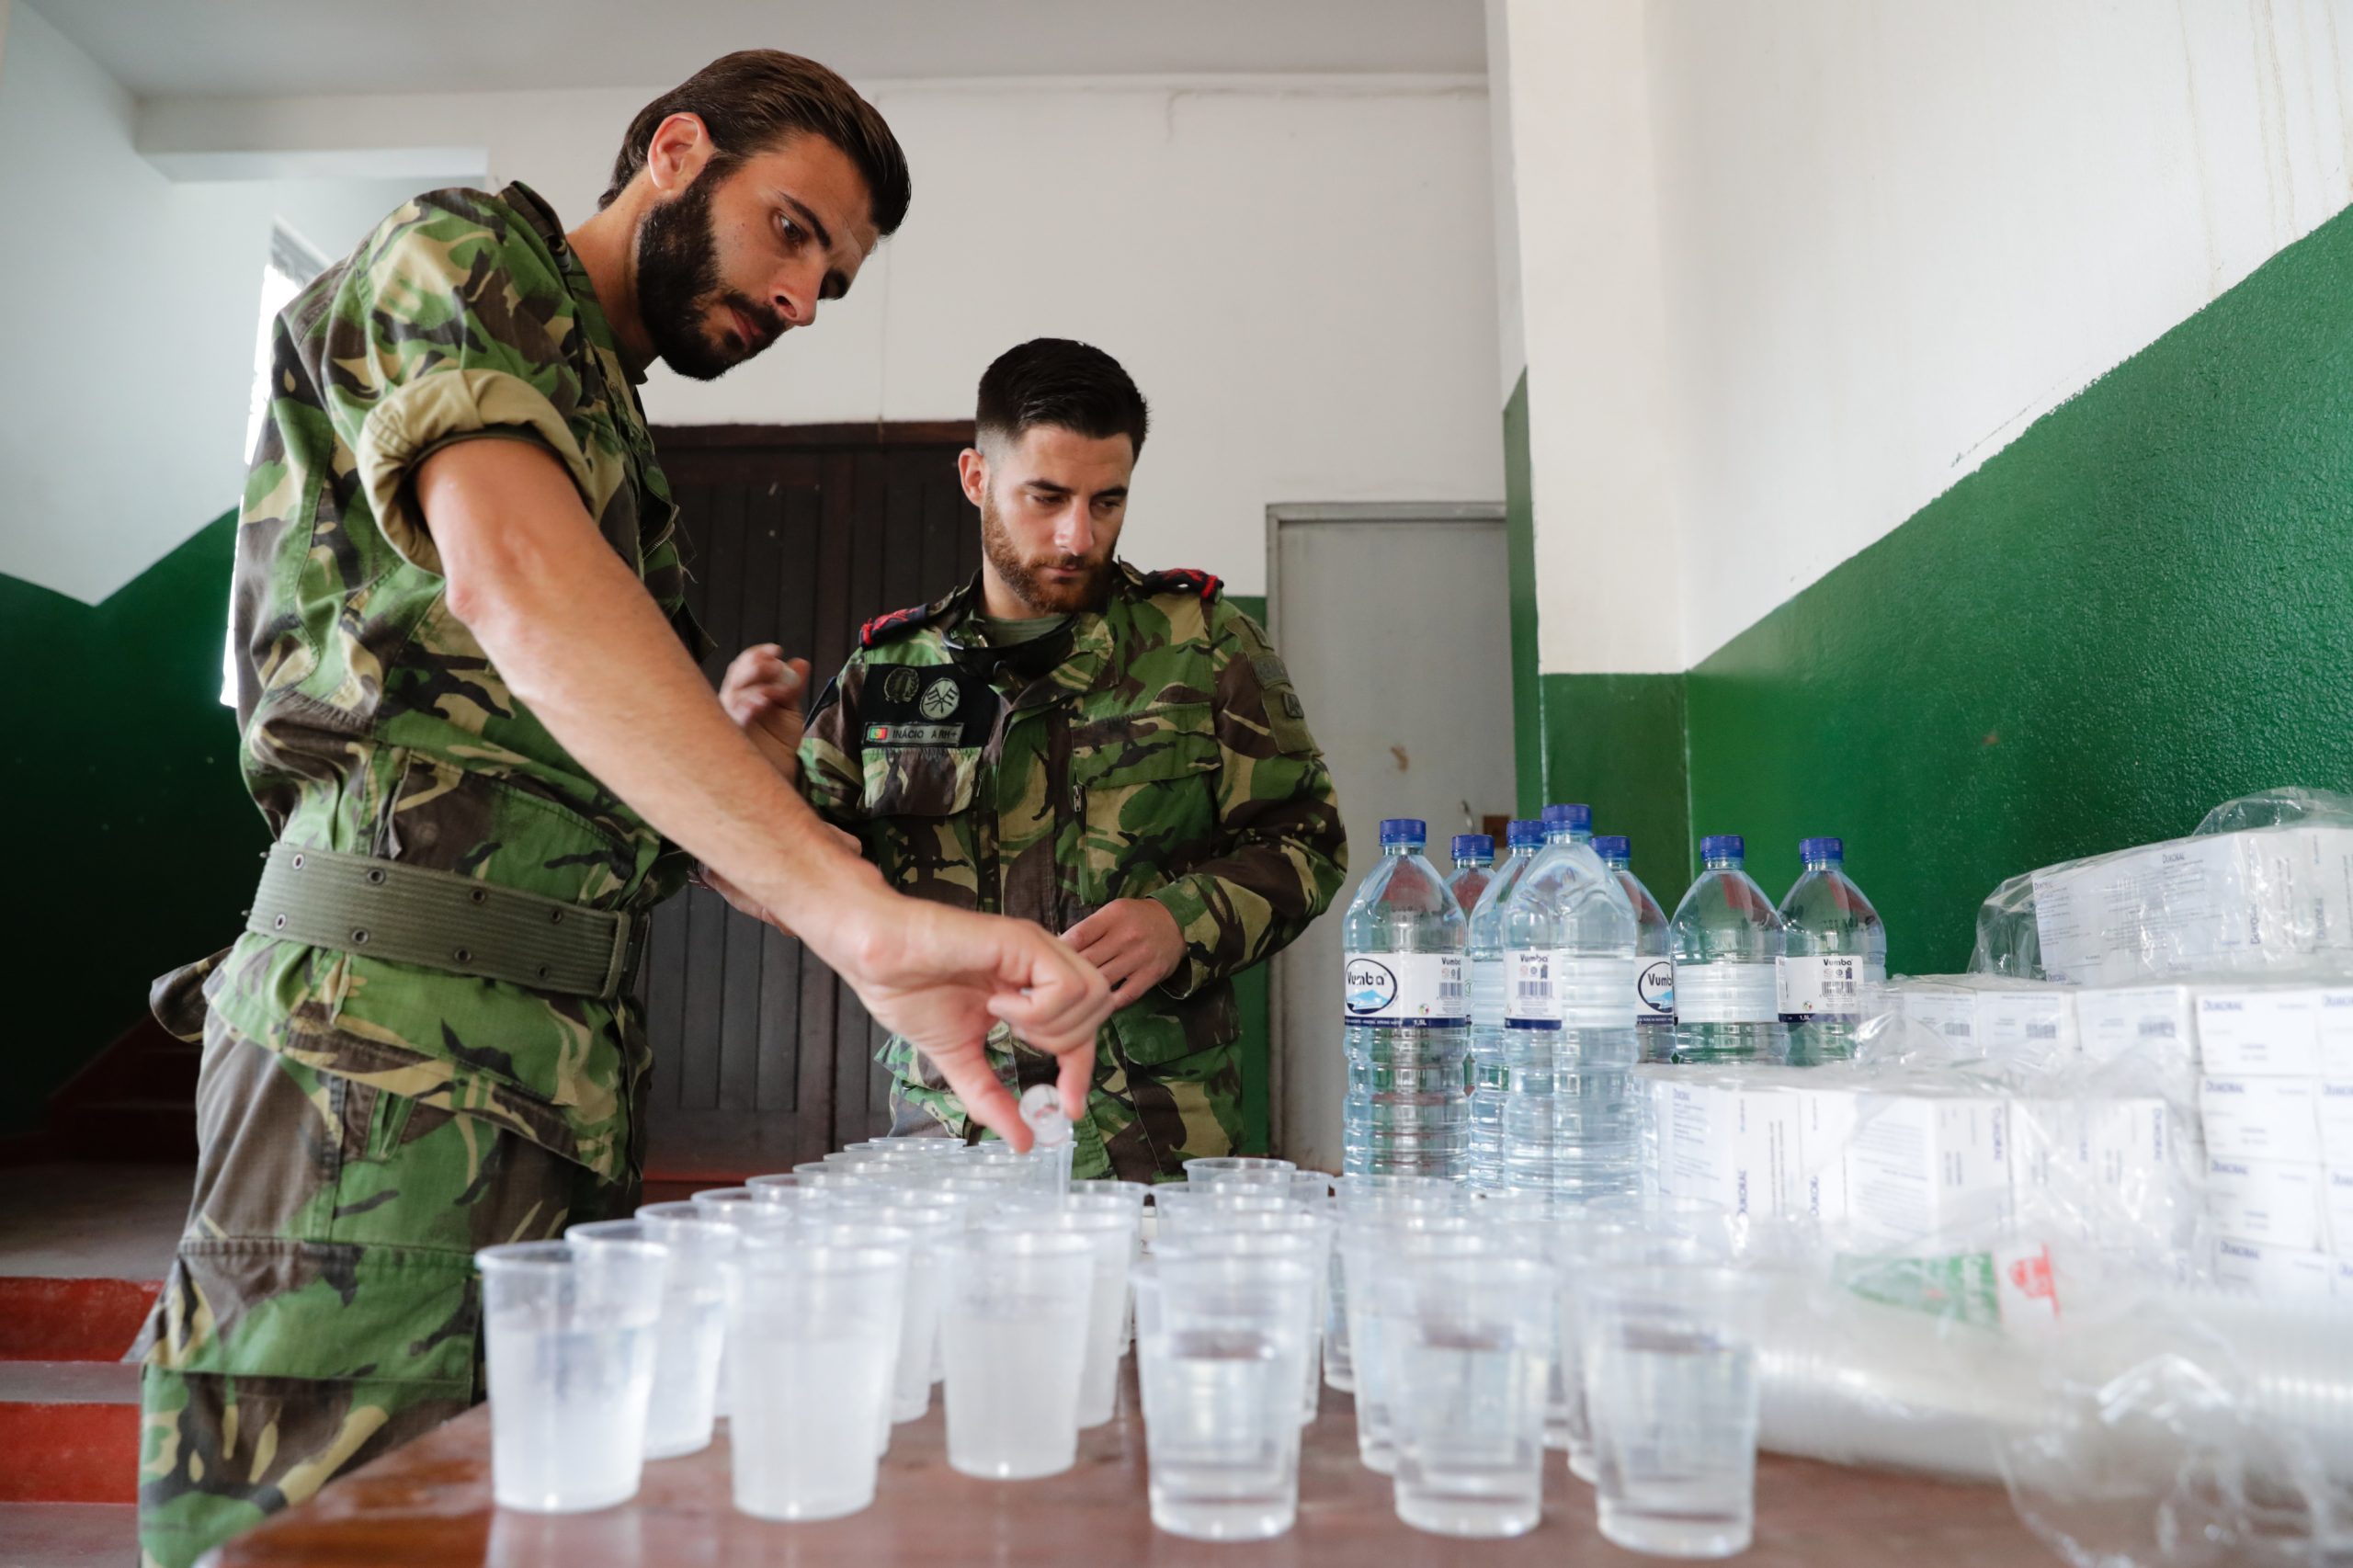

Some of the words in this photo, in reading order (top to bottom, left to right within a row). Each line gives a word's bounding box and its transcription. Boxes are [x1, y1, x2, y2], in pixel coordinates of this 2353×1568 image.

[892, 728, 925, 739] INÁCIO
[1520, 954, 1549, 962] Vumba
[1347, 971, 1385, 985] Vumba
[1648, 973, 1673, 986] Vumb
